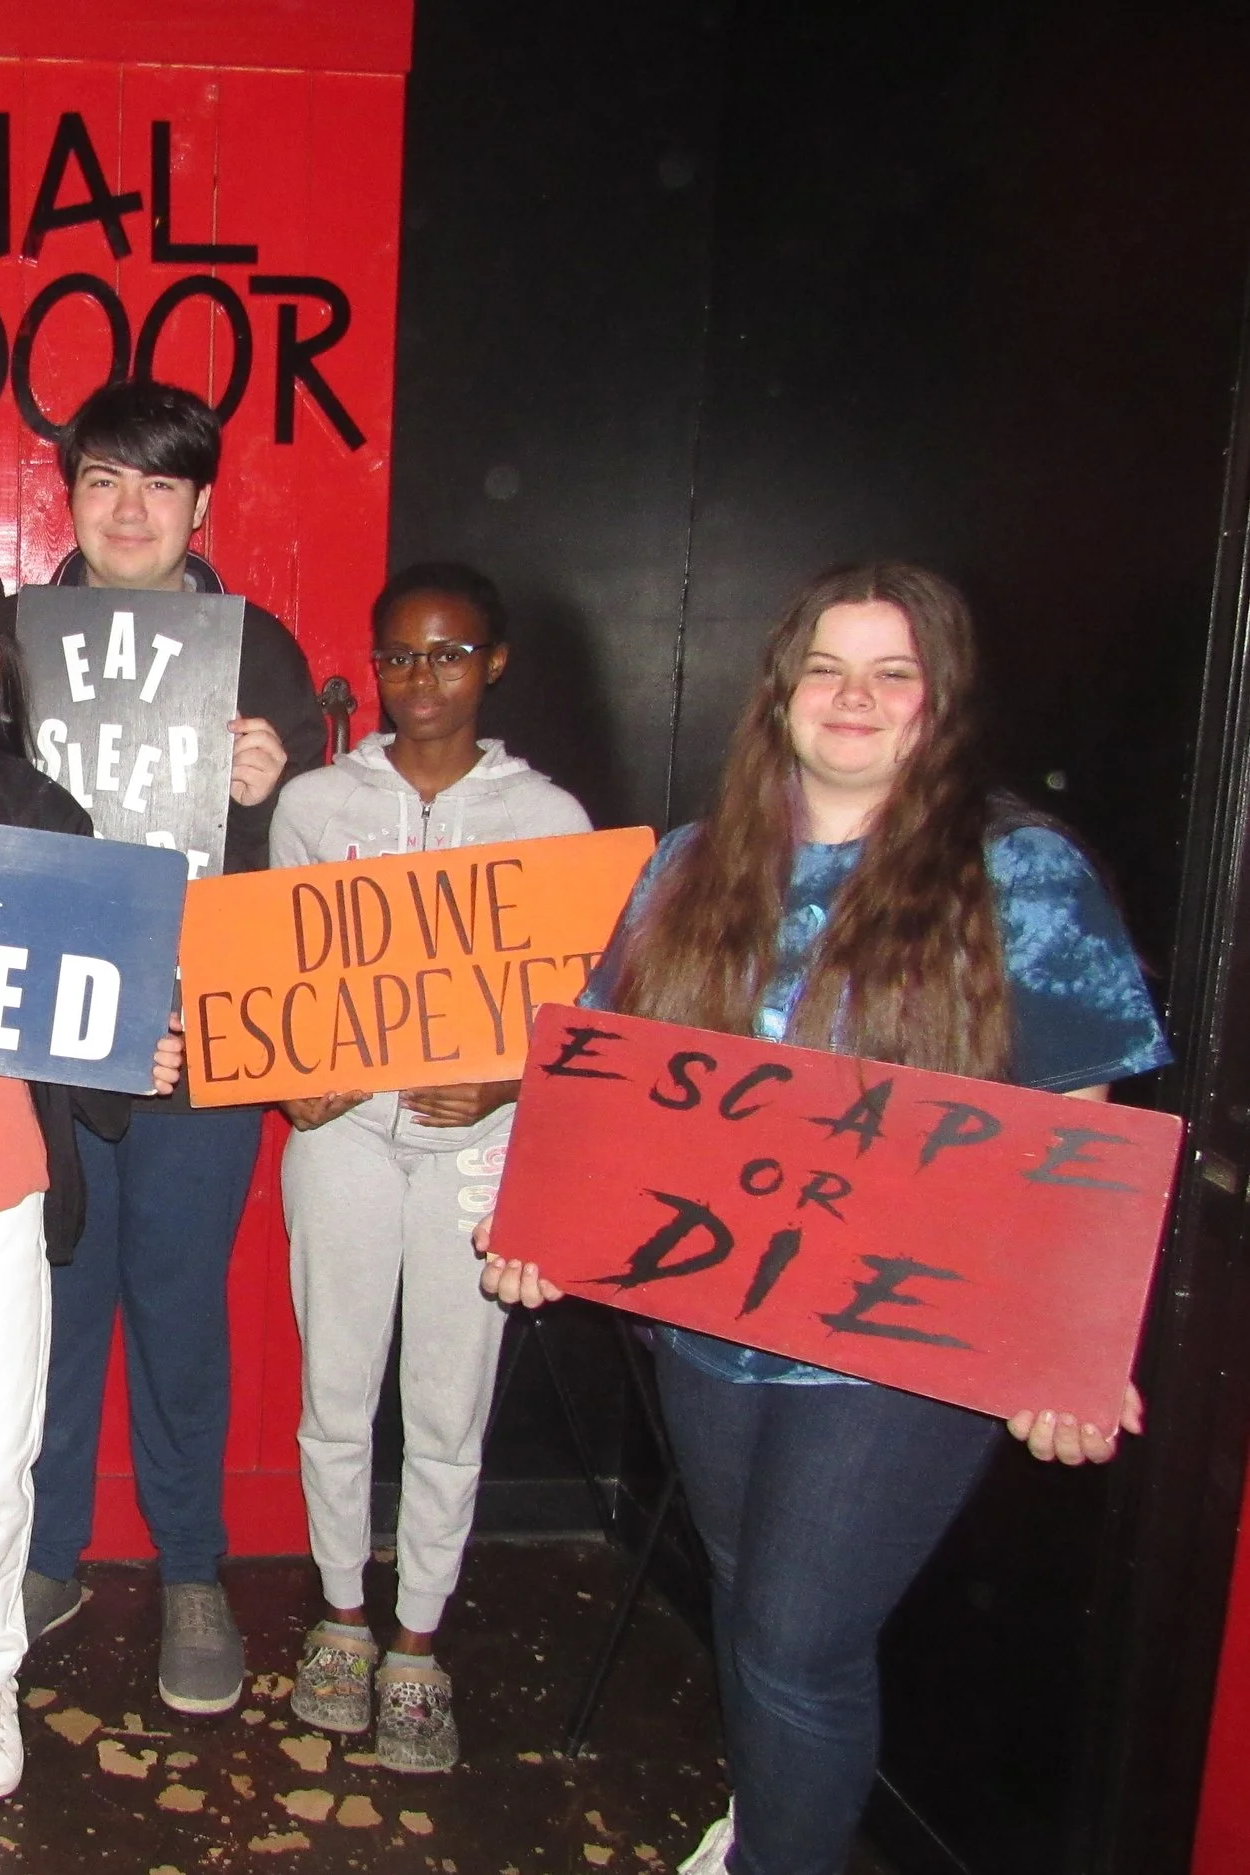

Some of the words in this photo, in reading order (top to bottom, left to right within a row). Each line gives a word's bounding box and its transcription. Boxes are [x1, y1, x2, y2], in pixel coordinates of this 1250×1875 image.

[61, 611, 184, 703] EAT
[33, 718, 199, 814] SLEEP
[291, 875, 392, 973] DID
[406, 858, 532, 961] WE
[197, 967, 461, 1083] ESCAPE
[537, 1025, 1144, 1193] ESCAPE
[740, 1157, 853, 1223] OR
[567, 1187, 991, 1352] DIE
